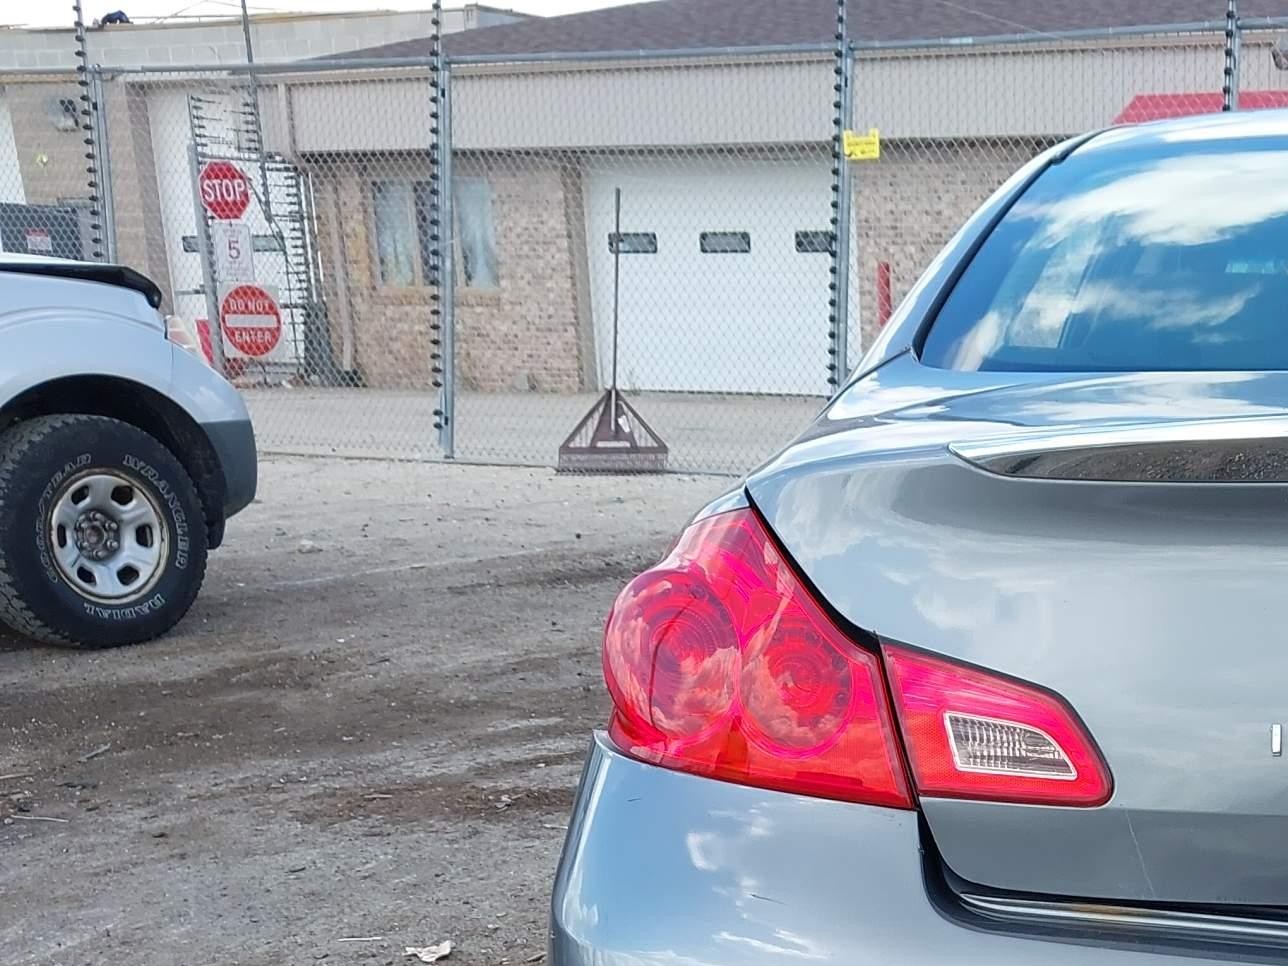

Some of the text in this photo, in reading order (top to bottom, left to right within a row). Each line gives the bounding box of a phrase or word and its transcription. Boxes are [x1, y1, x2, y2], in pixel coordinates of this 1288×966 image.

[203, 179, 245, 201] STOP
[228, 239, 241, 260] 5
[229, 300, 271, 313] DO NOT
[235, 331, 272, 343] ENTER
